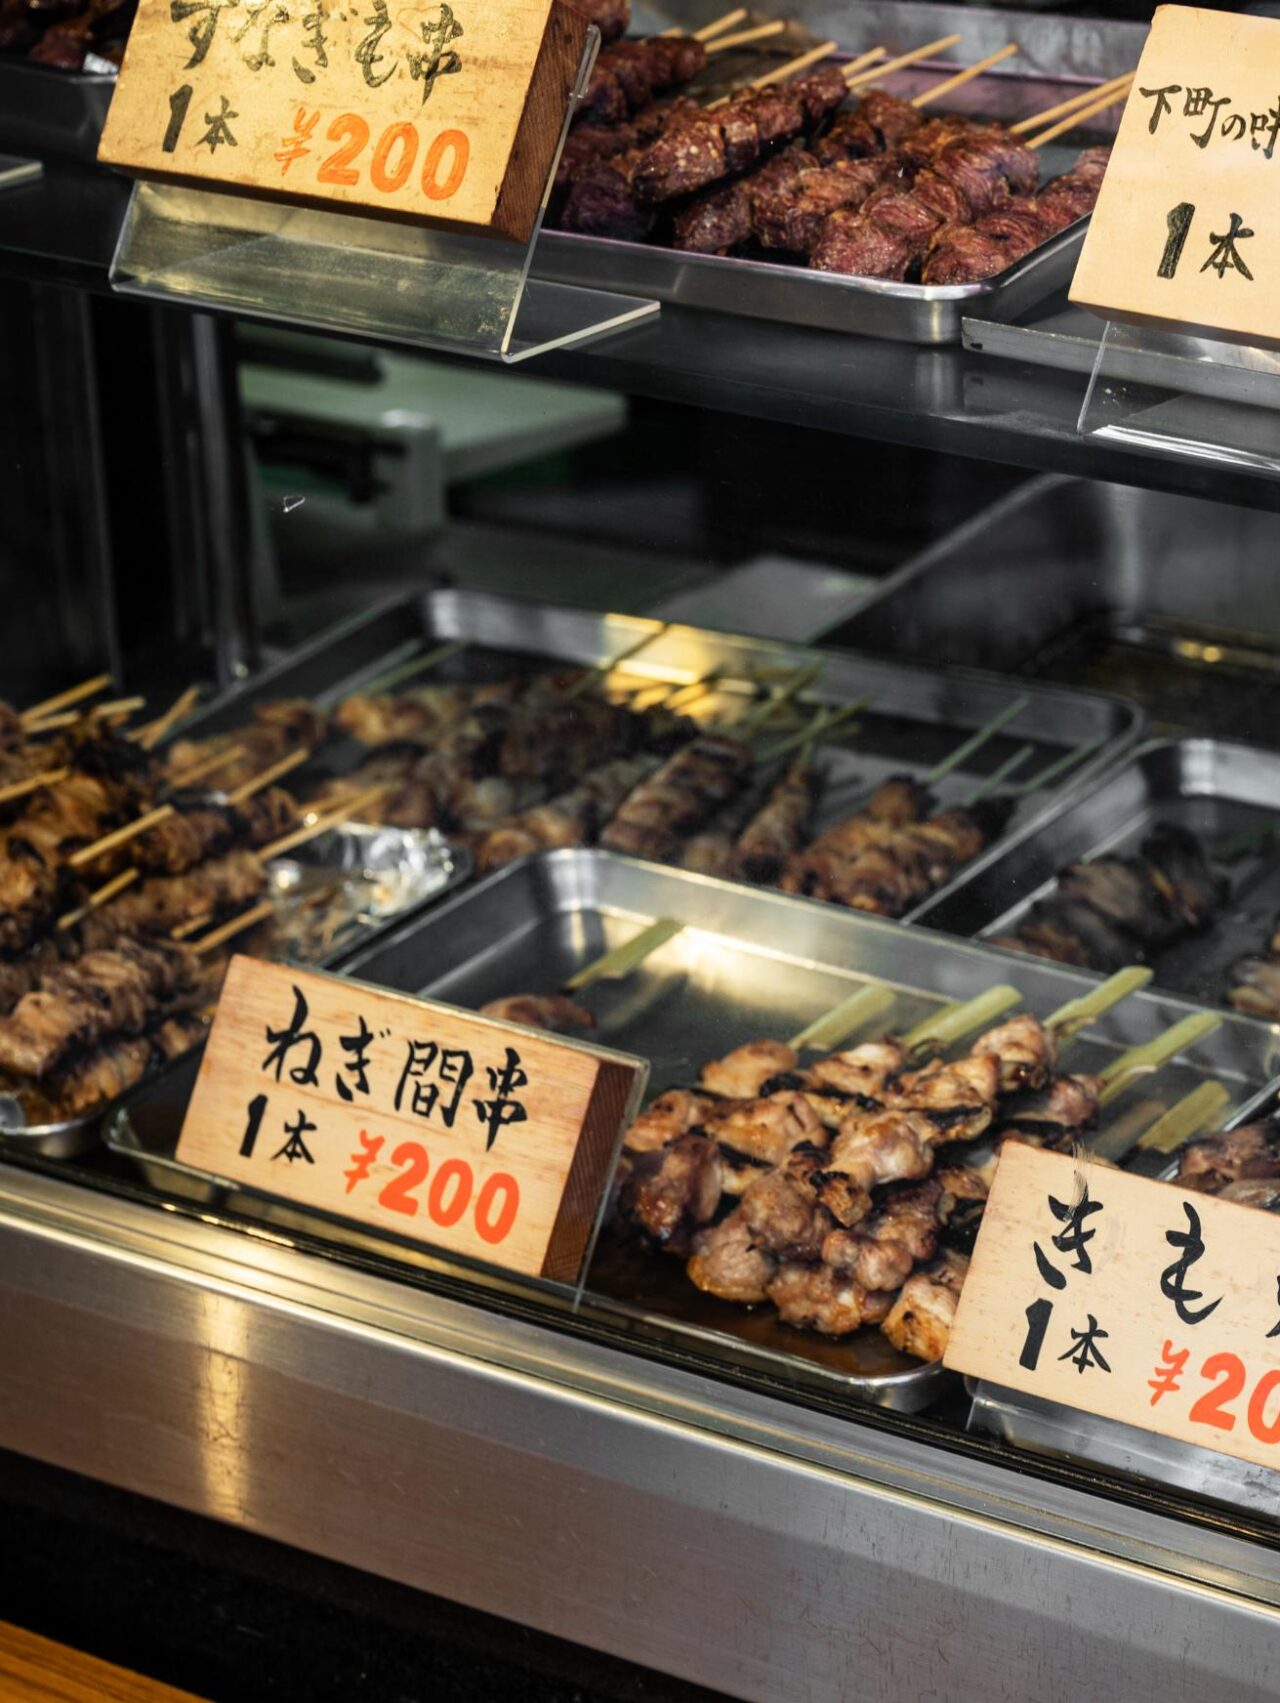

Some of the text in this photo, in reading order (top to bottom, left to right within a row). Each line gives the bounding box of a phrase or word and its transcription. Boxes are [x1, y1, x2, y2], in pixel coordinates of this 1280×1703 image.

[162, 84, 470, 201] 1本 ¥200
[1157, 202, 1254, 281] 1本
[261, 984, 529, 1153] ねぎ間串
[239, 1093, 521, 1246] 1本 ¥200
[1018, 1297, 1112, 1375] 1本
